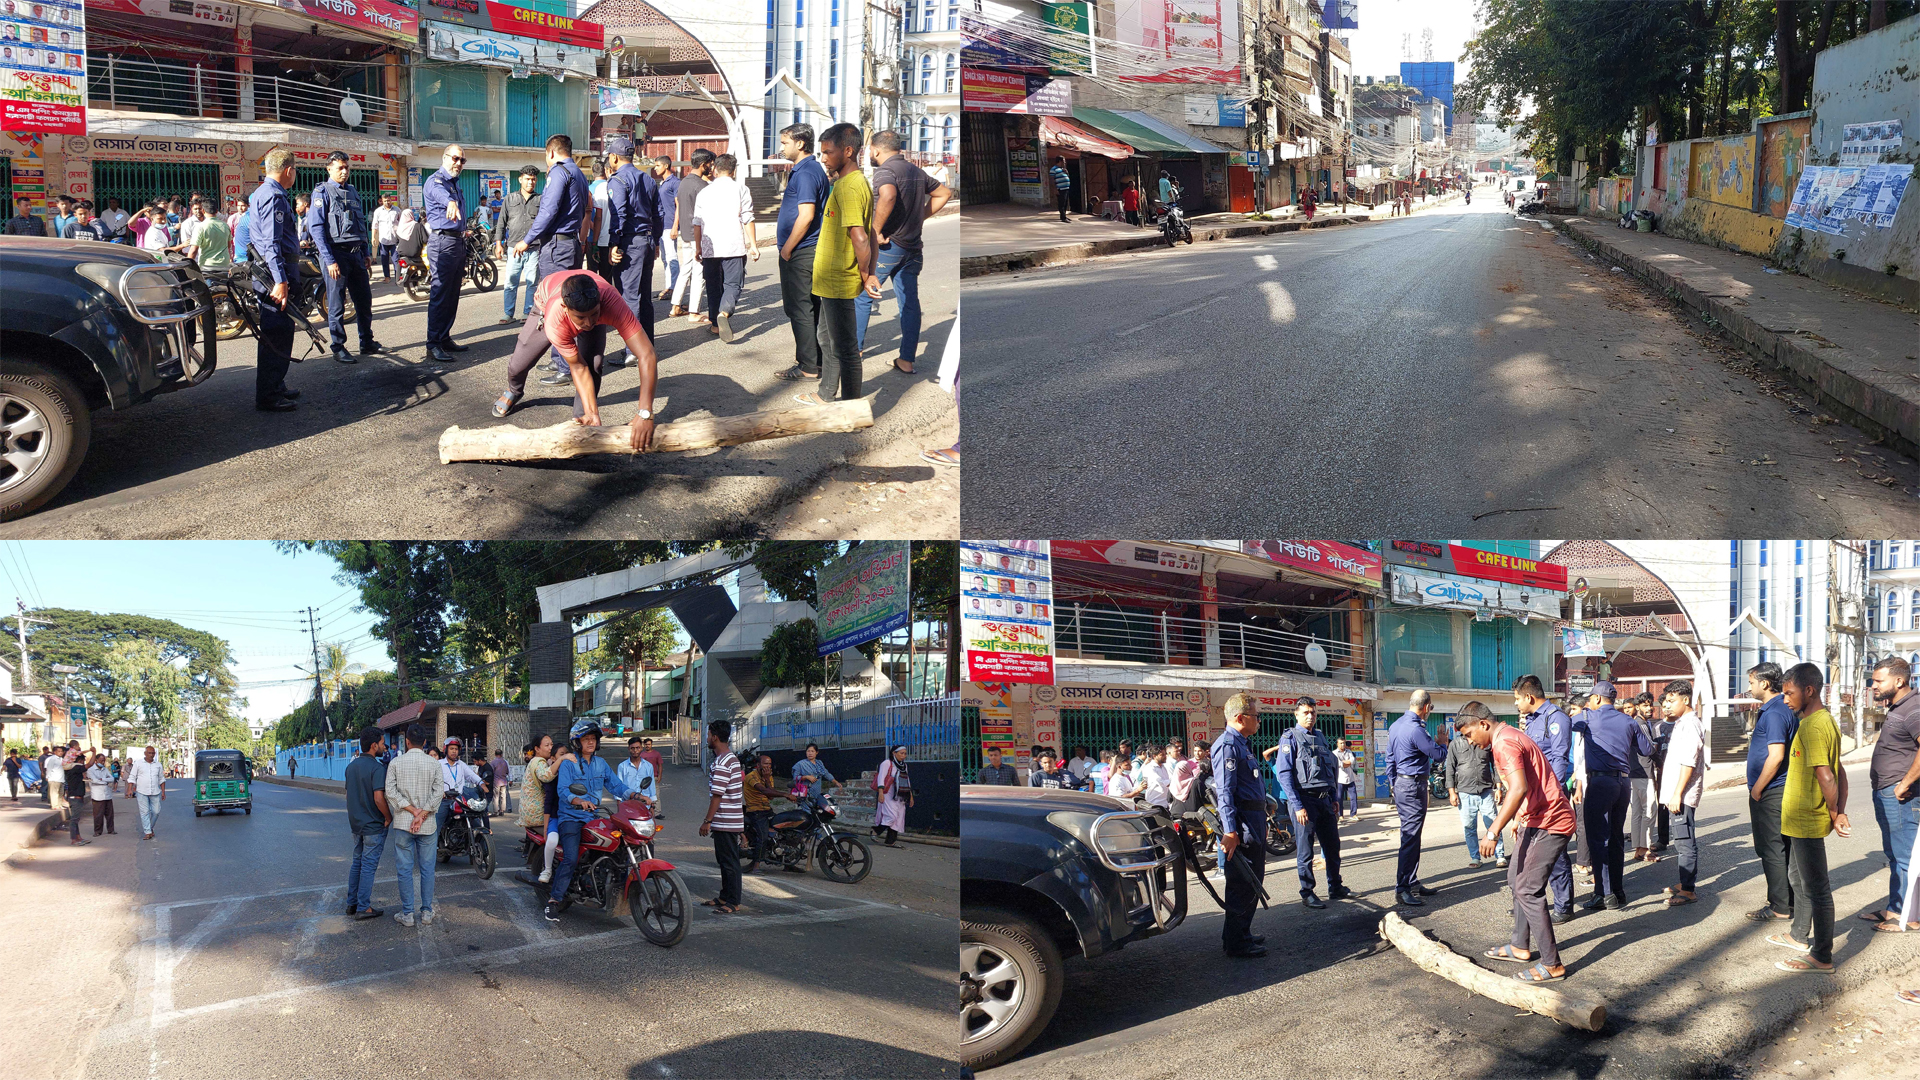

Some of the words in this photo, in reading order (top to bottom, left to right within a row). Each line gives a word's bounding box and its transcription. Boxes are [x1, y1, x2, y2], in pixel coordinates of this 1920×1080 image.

[363, 10, 402, 32] পার্লার
[513, 8, 545, 25] CAFE
[548, 15, 574, 30] LINK
[13, 71, 77, 90] শুভেচ্ছা
[35, 82, 51, 92] ও
[964, 71, 985, 81] ENGLISH
[986, 74, 1007, 84] THERAPY
[1009, 76, 1025, 85] CENTRE
[1, 85, 82, 107] অভিনন্দন
[94, 136, 139, 150] মেসার্স
[139, 141, 172, 152] তোহা
[174, 142, 218, 153] ফ্যাশন
[68, 170, 88, 179] মেসার্স
[860, 551, 902, 582] অভিযান
[1278, 541, 1321, 562] বিউটি
[1327, 555, 1366, 576] পার্লার
[1476, 551, 1508, 568] CAFE
[1511, 558, 1537, 573] LINK
[981, 622, 1044, 639] শুভেচ্ছা
[1002, 633, 1018, 642] ও
[970, 636, 1049, 657] অভিনন্দন
[1061, 684, 1106, 698] মেসার্স
[1106, 688, 1139, 699] তোহা
[1141, 689, 1184, 701] ফ্যাশন
[1036, 718, 1057, 727] মেসার্স
